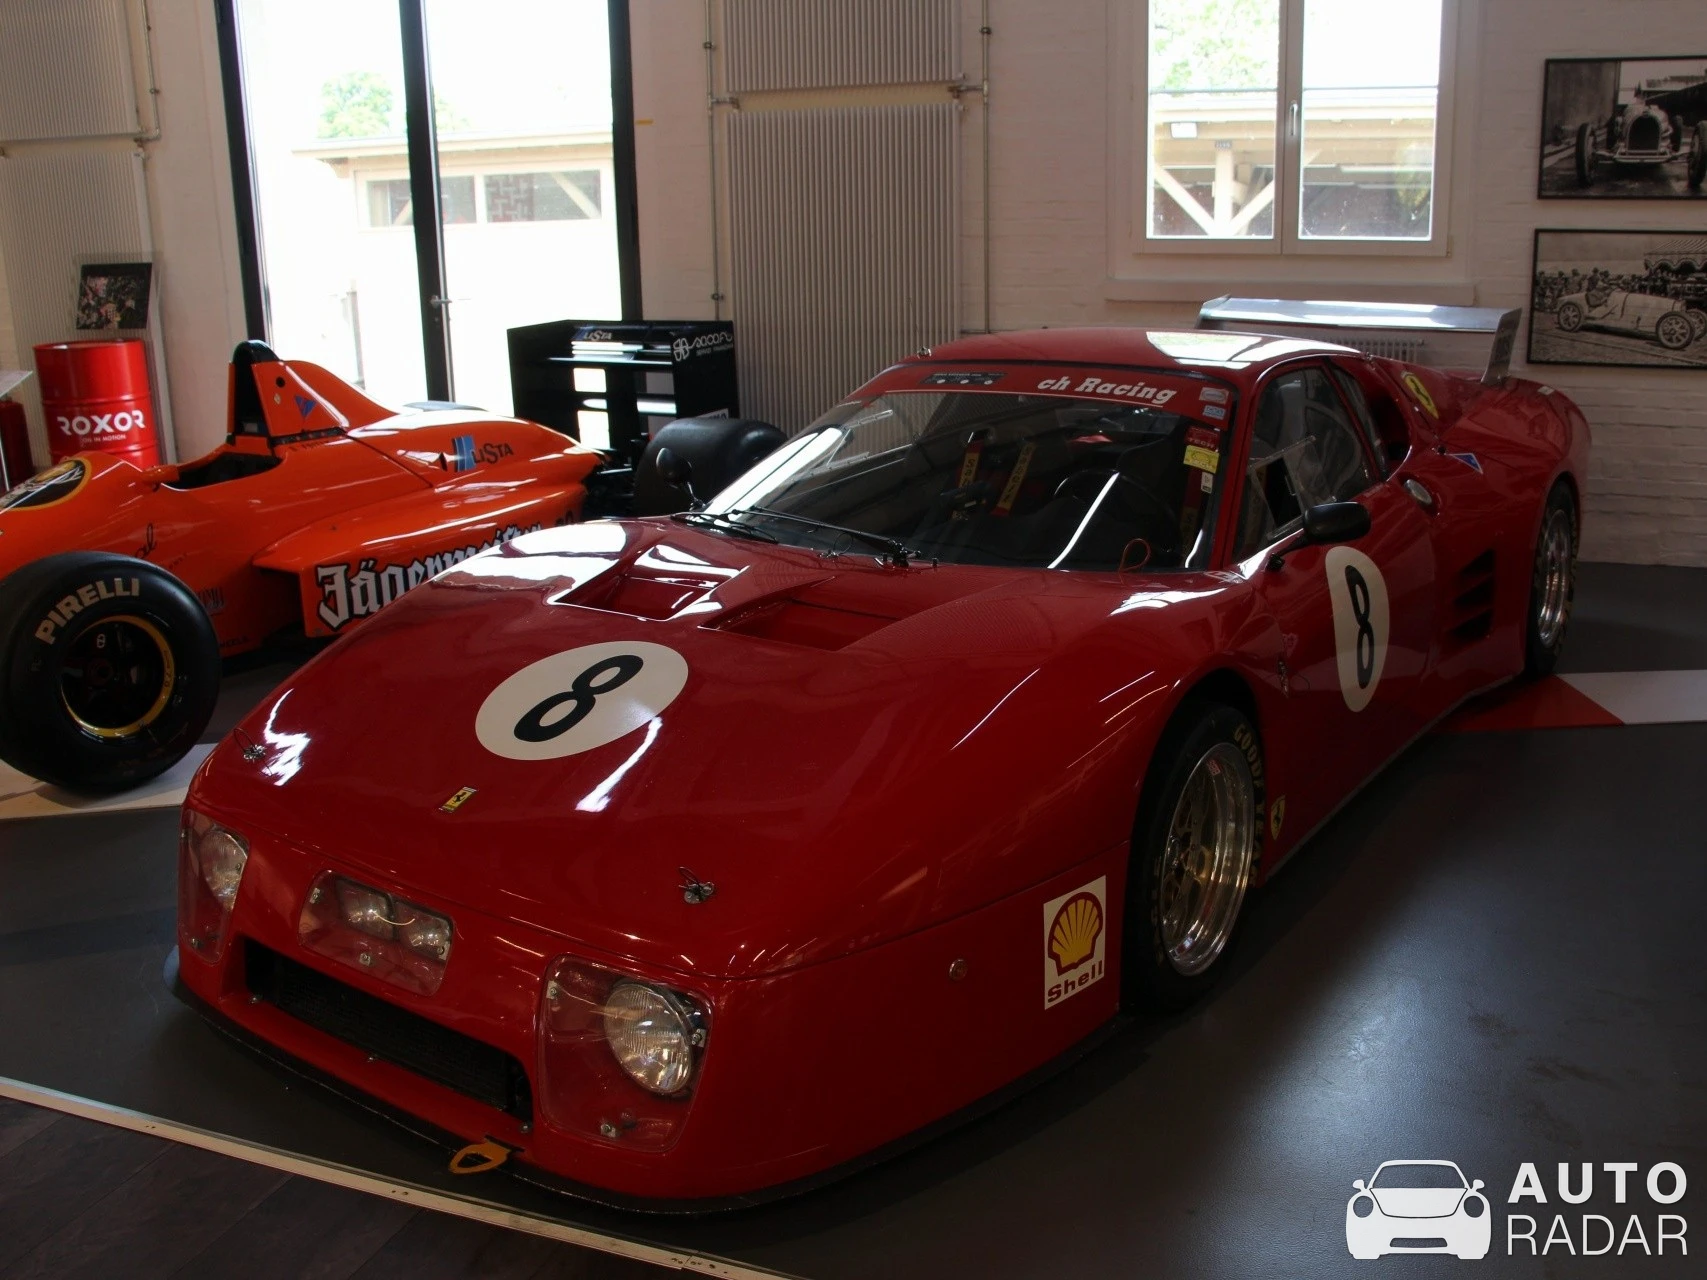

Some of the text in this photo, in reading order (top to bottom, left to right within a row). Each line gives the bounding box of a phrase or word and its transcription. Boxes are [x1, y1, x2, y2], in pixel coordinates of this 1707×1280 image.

[1037, 376, 1177, 404] ch Racing
[57, 409, 145, 436] ROXOR
[103, 434, 126, 442] MOTION
[473, 442, 514, 465] LISTA
[34, 577, 141, 645] PIRELLI
[1344, 565, 1375, 689] 8
[514, 655, 643, 742] 8
[1047, 960, 1103, 1003] Shell
